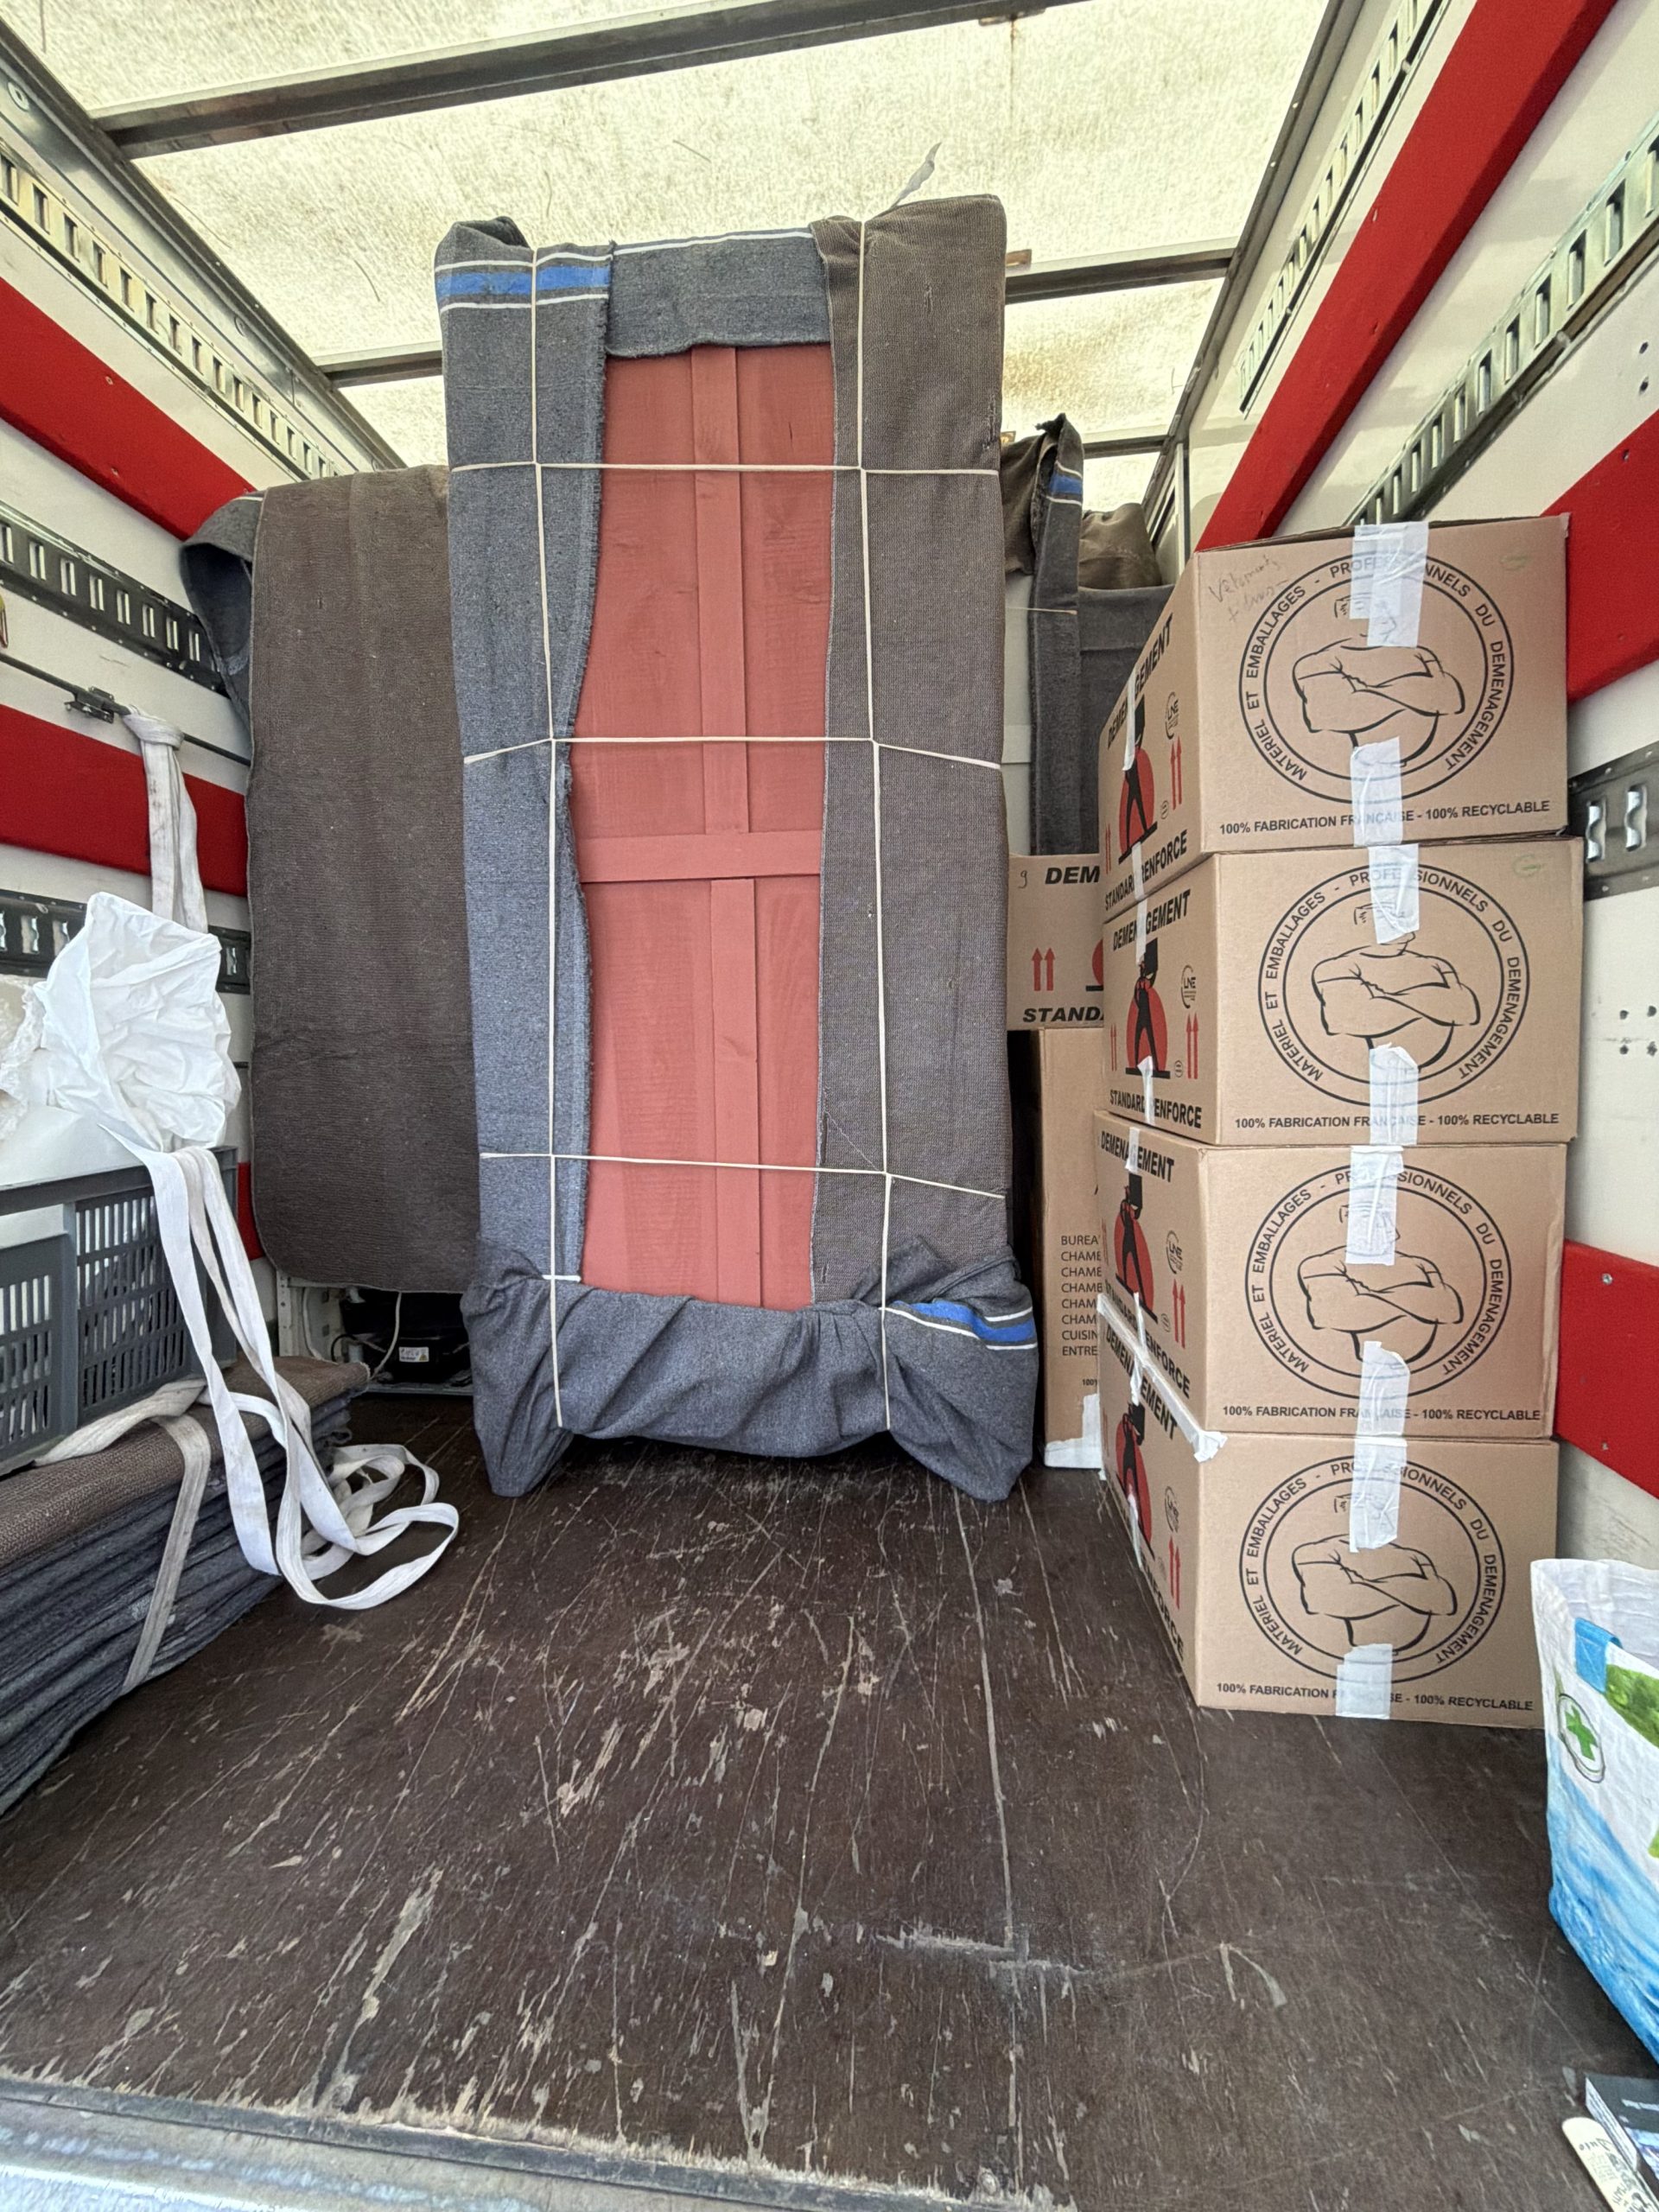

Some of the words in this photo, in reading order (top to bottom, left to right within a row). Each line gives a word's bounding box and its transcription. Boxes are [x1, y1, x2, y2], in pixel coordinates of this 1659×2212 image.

[1475, 604, 1495, 627] DU
[1246, 586, 1306, 678] EMBALLAGES
[1247, 691, 1260, 709] ET
[1445, 641, 1505, 771] DEMENAGEMENT
[1254, 719, 1308, 780] MATERIEL
[1220, 822, 1250, 835] 100%
[1255, 814, 1336, 832] FABRICATION
[1426, 806, 1459, 819] 100%
[1462, 800, 1550, 817] RECYCLABLE
[1045, 866, 1100, 884] DEM
[1105, 874, 1135, 911] STANDAR
[1113, 888, 1191, 951] DEMENGEMENT
[1491, 920, 1513, 942] DU
[1266, 891, 1325, 980] EMBALLAGES
[1022, 1007, 1104, 1022] STAND
[1266, 992, 1278, 1009] ET
[1458, 957, 1521, 1078] DEMENAGEMENT
[1272, 1020, 1324, 1081] MATERIEL
[1154, 1097, 1202, 1128] ENFORCE
[1236, 1118, 1265, 1128] 100%
[1268, 1116, 1350, 1128] FABRICATION
[1438, 1115, 1469, 1125] 100%
[1472, 1113, 1560, 1125] RECYCLABLE
[1101, 1130, 1174, 1183] DEMENAEMENT
[1061, 1235, 1101, 1245] BUREA
[1252, 1189, 1312, 1274] EMBALLAGES
[1476, 1222, 1497, 1246] DU
[1062, 1299, 1096, 1308] CHAM
[1253, 1284, 1265, 1302] ET
[1062, 1315, 1096, 1324] CHAM
[1441, 1259, 1503, 1376] DEMENAGEMENT
[1062, 1346, 1098, 1356] ENTRE
[1258, 1312, 1310, 1374] MATERIEL
[1146, 1332, 1192, 1399] ENFORCE
[1224, 1406, 1253, 1418] 100%
[1256, 1407, 1336, 1419] FABRICATION
[1422, 1408, 1453, 1420] 100%
[1457, 1408, 1541, 1421] RECYCLABLE
[1246, 1478, 1307, 1559] EMBALLAGES
[1470, 1518, 1489, 1541] DU
[1247, 1568, 1260, 1586] ET
[1435, 1554, 1497, 1665] DEMENAGEMENT
[1254, 1595, 1304, 1656] MATERIEL
[1217, 1682, 1246, 1695] 100%
[1249, 1684, 1329, 1699] FABRICATION
[1414, 1694, 1445, 1707] 100%
[1448, 1695, 1533, 1712] RECYCLABLE
